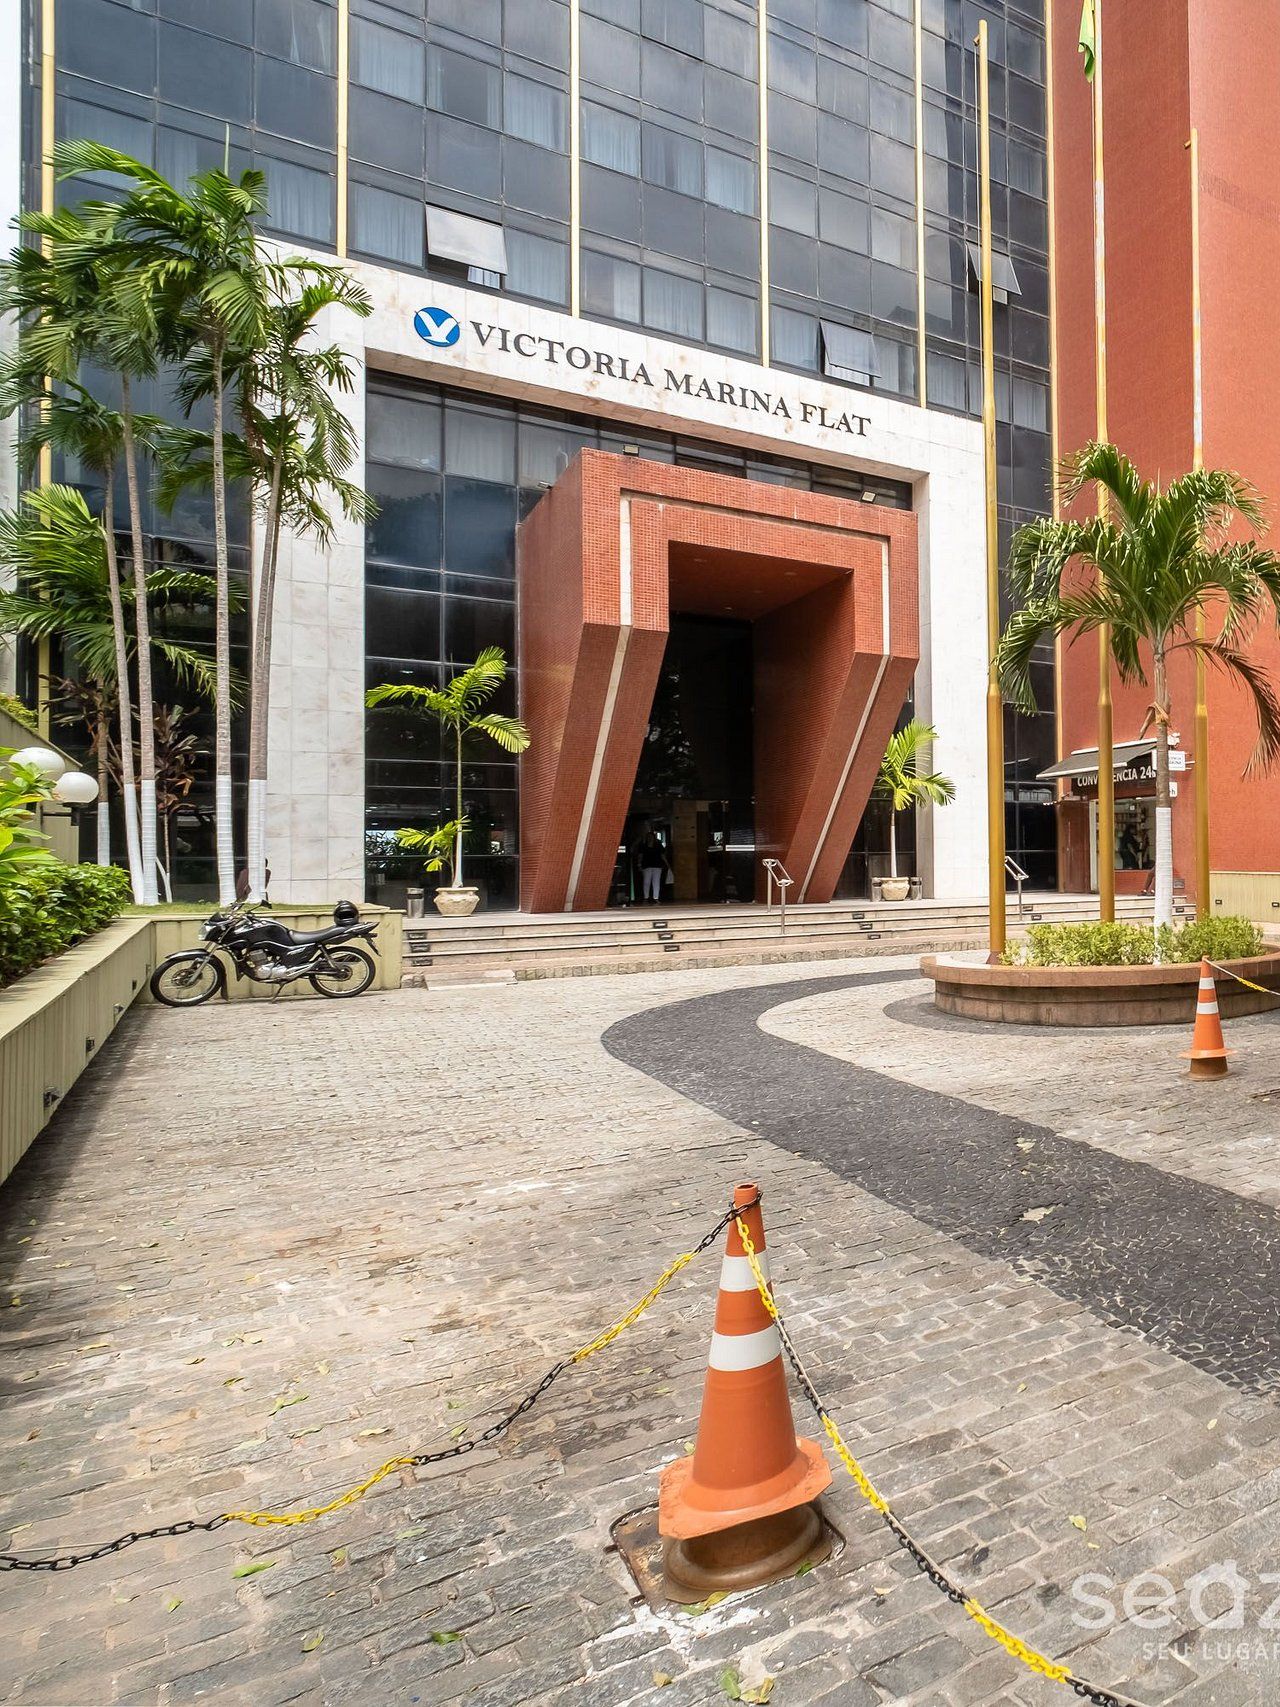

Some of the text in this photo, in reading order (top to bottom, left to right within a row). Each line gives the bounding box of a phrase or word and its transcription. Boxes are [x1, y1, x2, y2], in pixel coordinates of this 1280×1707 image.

[469, 321, 872, 438] VICTORIA MARINA FLAT
